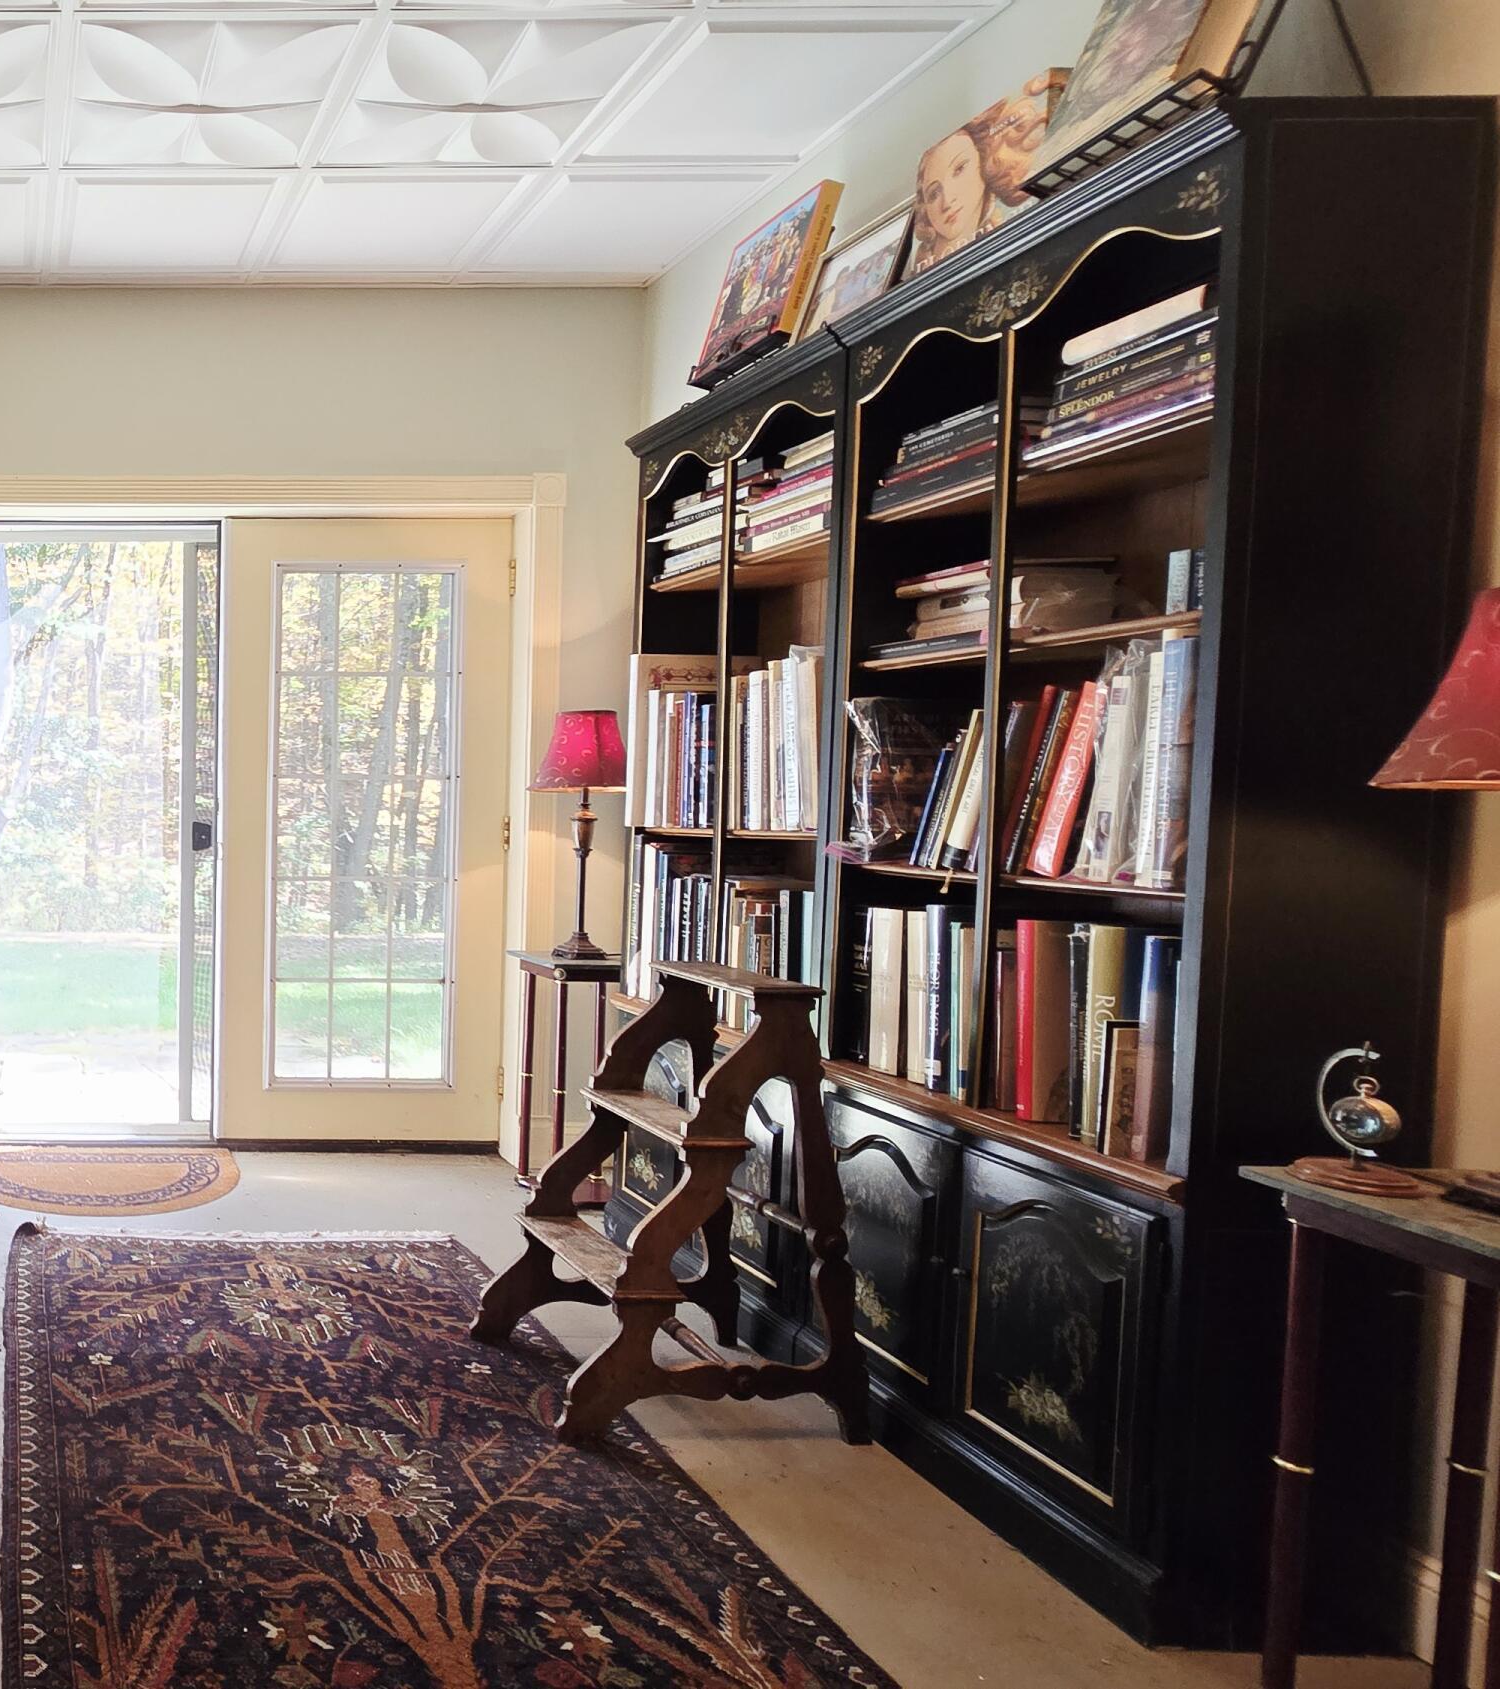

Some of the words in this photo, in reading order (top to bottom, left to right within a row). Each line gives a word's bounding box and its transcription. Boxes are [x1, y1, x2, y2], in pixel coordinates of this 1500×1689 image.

[1074, 363, 1128, 391] JEWELRY
[1059, 389, 1116, 418] SPLENDOR
[1055, 700, 1095, 797] HISTORY
